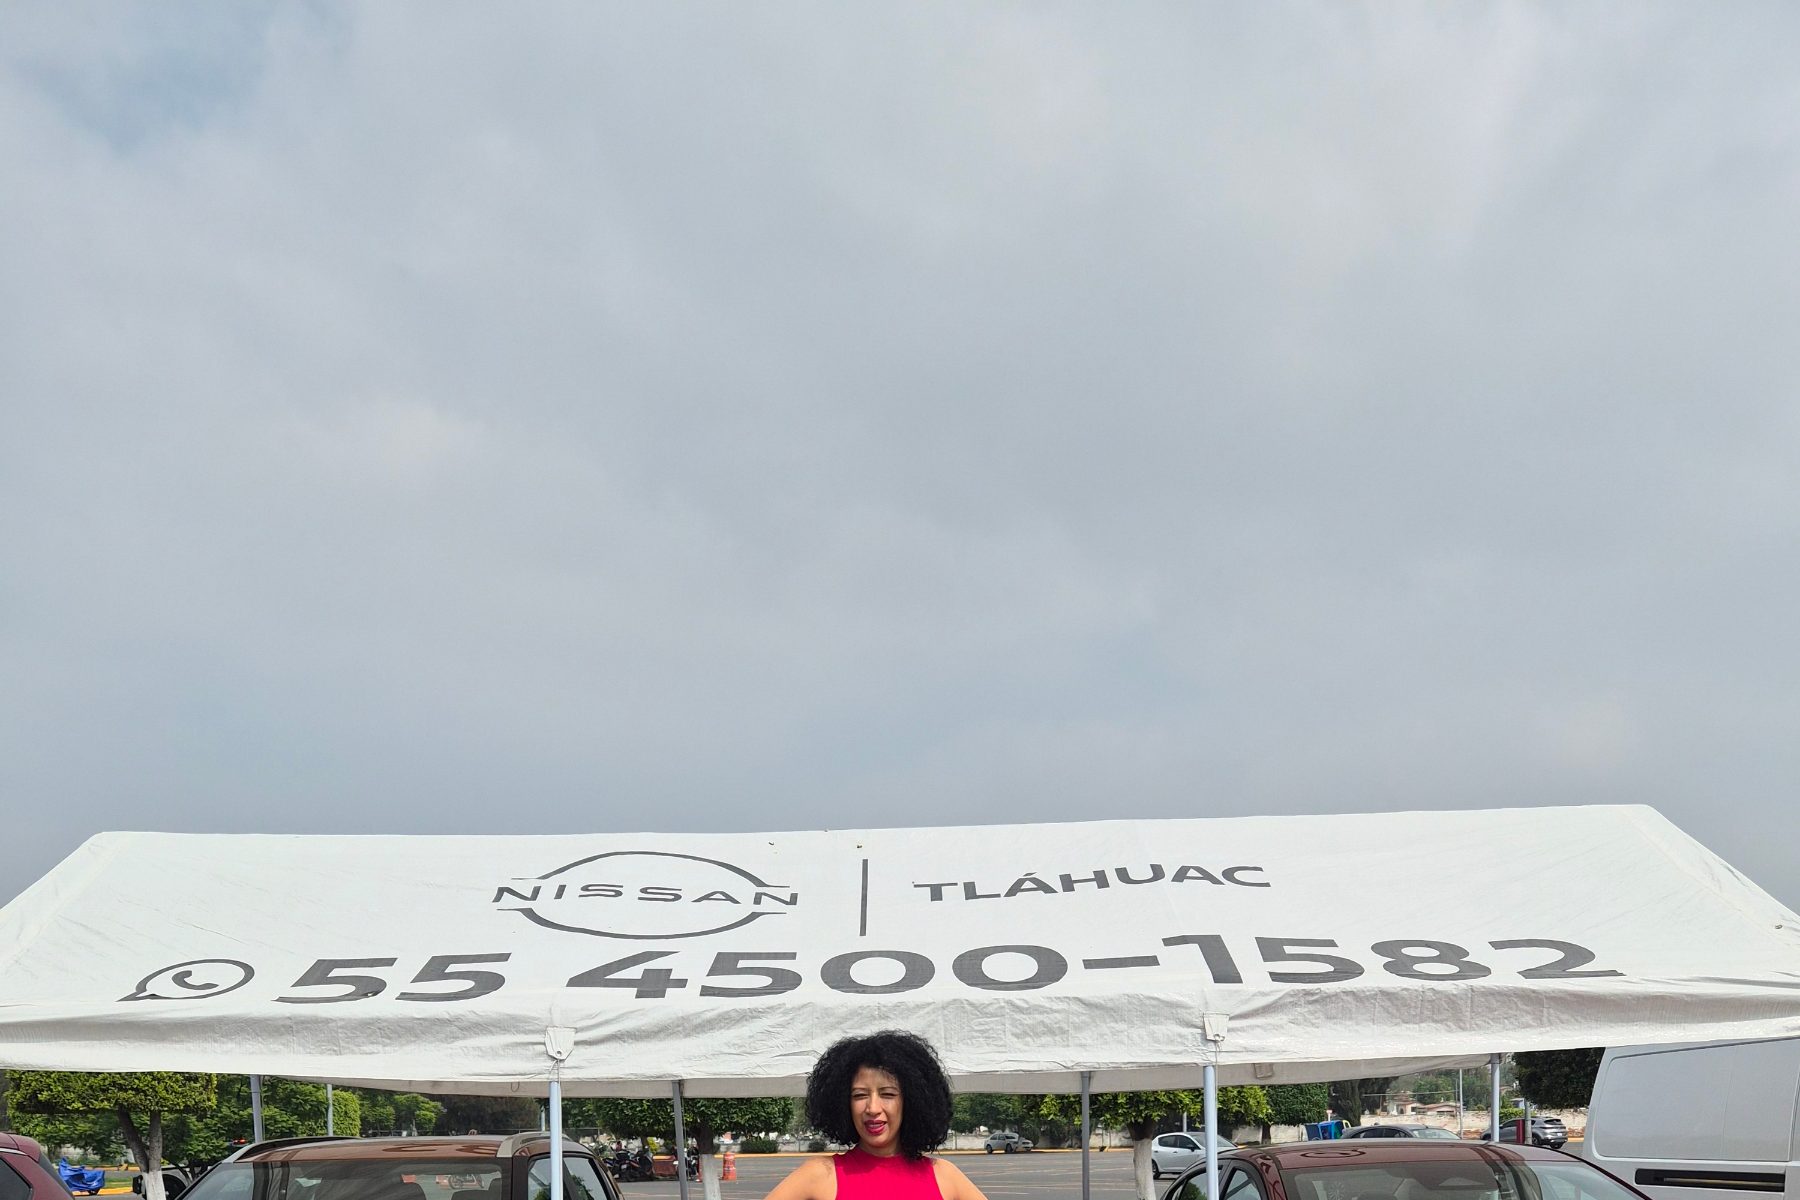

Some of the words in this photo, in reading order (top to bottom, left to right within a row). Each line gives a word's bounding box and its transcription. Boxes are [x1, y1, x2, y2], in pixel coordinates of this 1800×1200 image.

[492, 883, 799, 906] NISSAN
[912, 863, 1272, 902] TLÁHUAC
[271, 952, 512, 1004] 55
[565, 934, 1626, 999] 4500-1582
